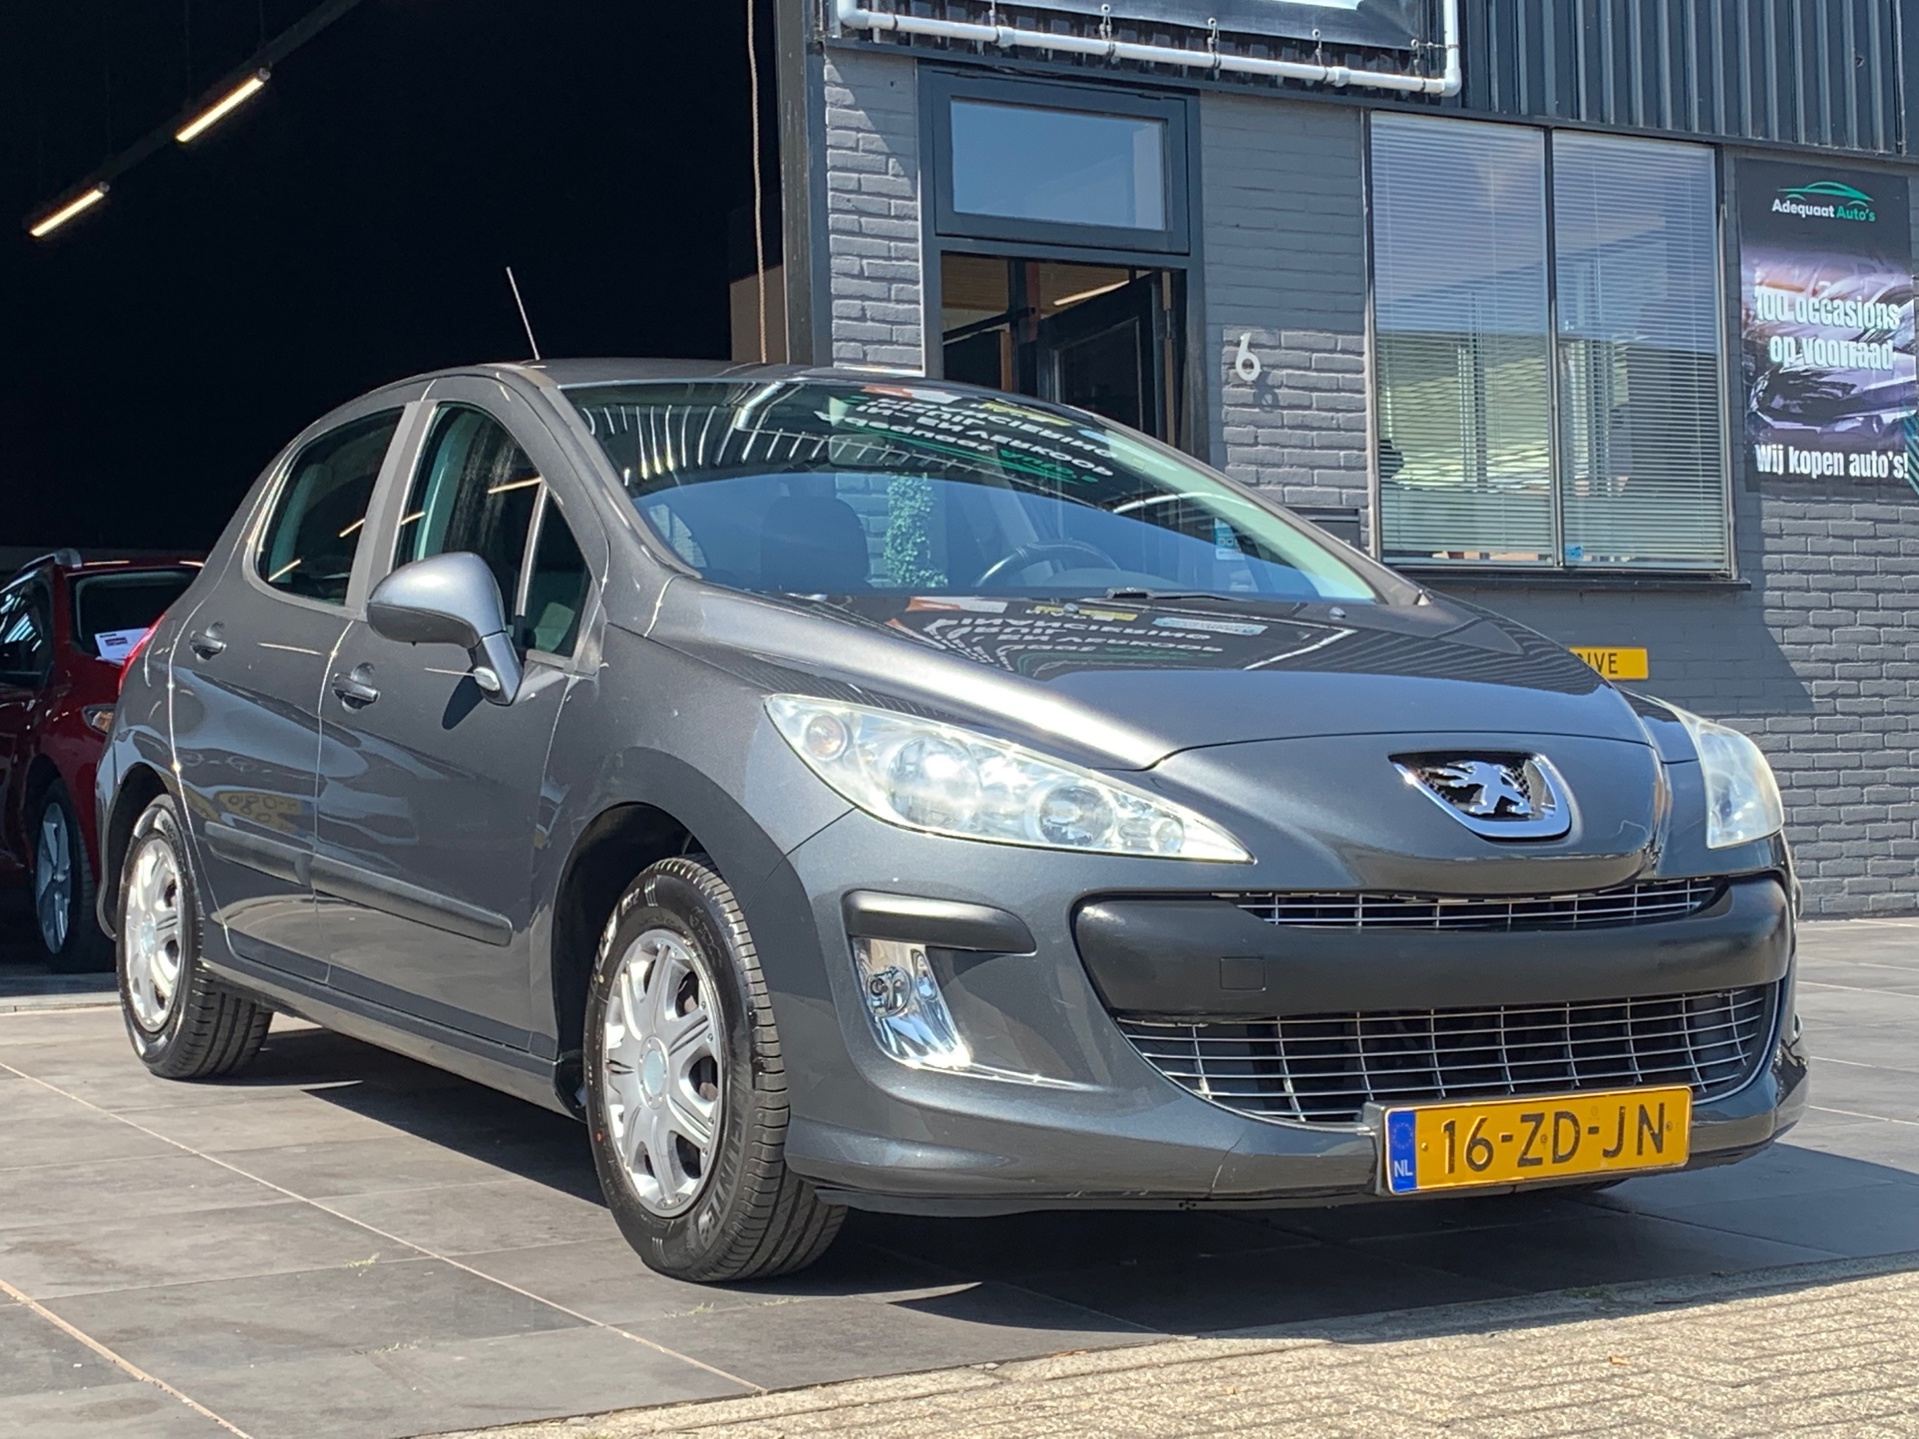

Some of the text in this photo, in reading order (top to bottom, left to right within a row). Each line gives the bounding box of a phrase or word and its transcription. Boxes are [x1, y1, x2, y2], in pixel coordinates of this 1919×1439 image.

[1772, 199, 1876, 222] Adequaat Auto's
[1755, 288, 1900, 330] 100 occasions
[1235, 332, 1261, 382] 6
[1769, 335, 1894, 371] op voorraad
[1755, 444, 1910, 479] Wij kopen auto's!
[1577, 652, 1618, 675] IVE
[1441, 1102, 1666, 1175] 16-ZD-JN
[1393, 1159, 1413, 1177] NL
